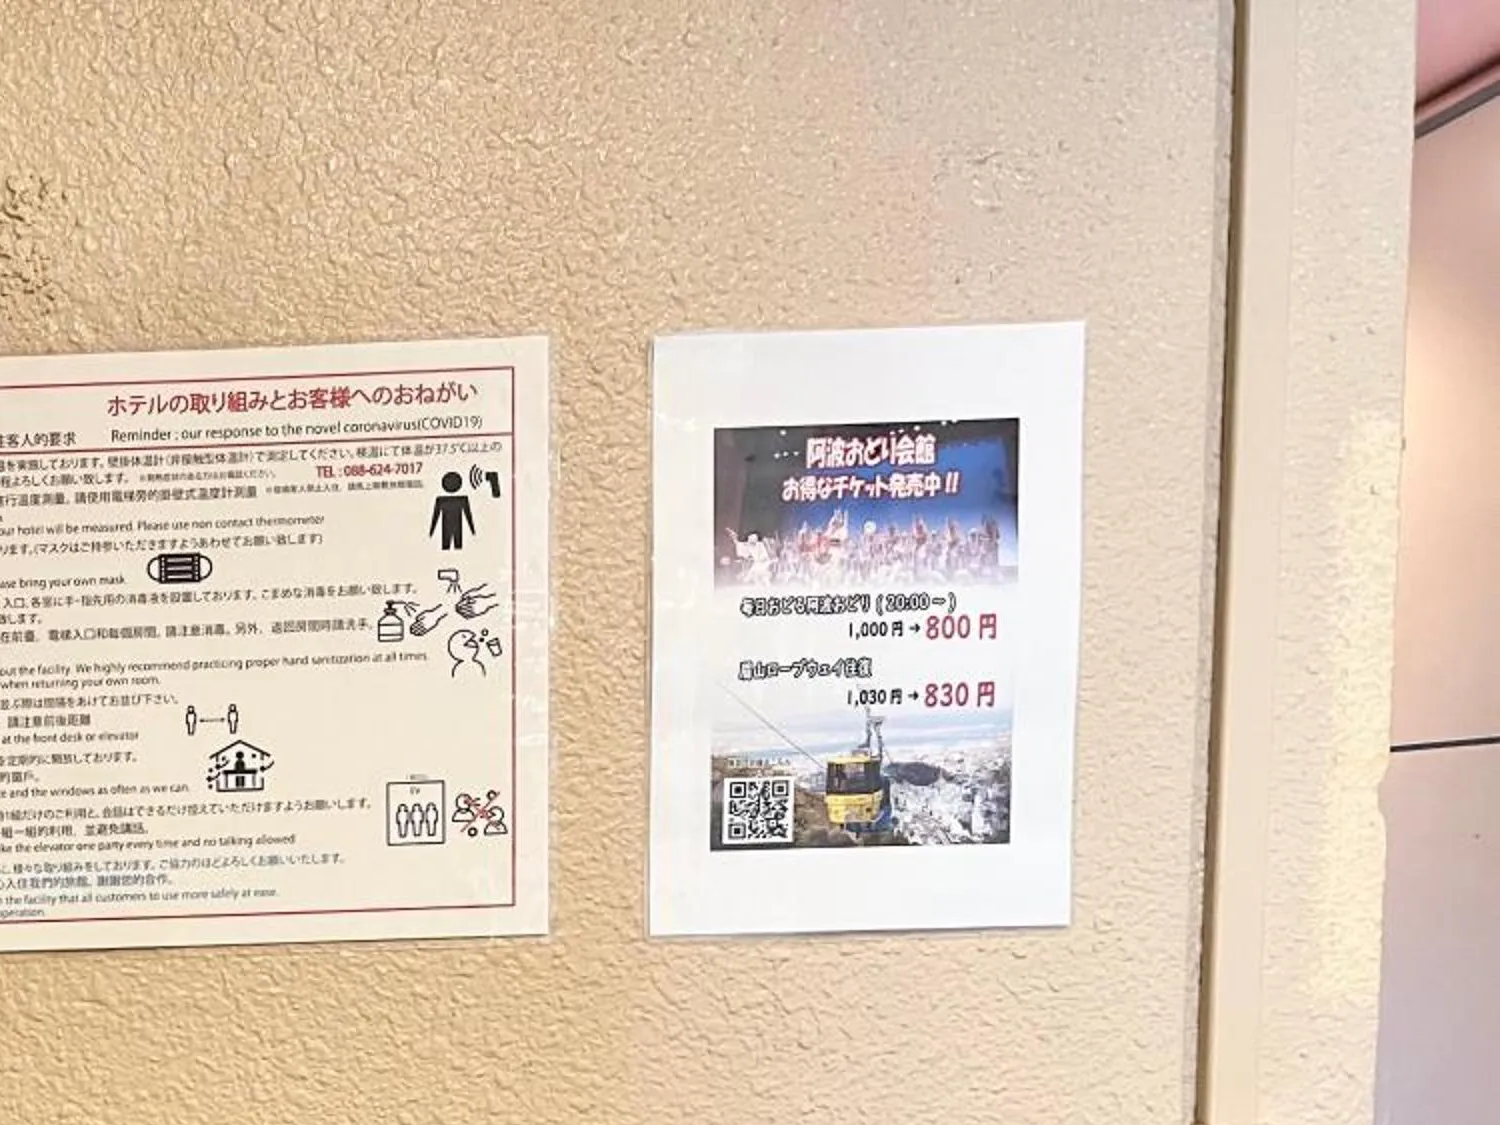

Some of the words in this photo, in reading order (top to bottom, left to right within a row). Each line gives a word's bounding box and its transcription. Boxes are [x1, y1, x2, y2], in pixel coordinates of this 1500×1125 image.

[107, 380, 478, 417] ホテルの取り組みとお客様へのおねがい
[806, 433, 936, 469] 阿波おどり会館
